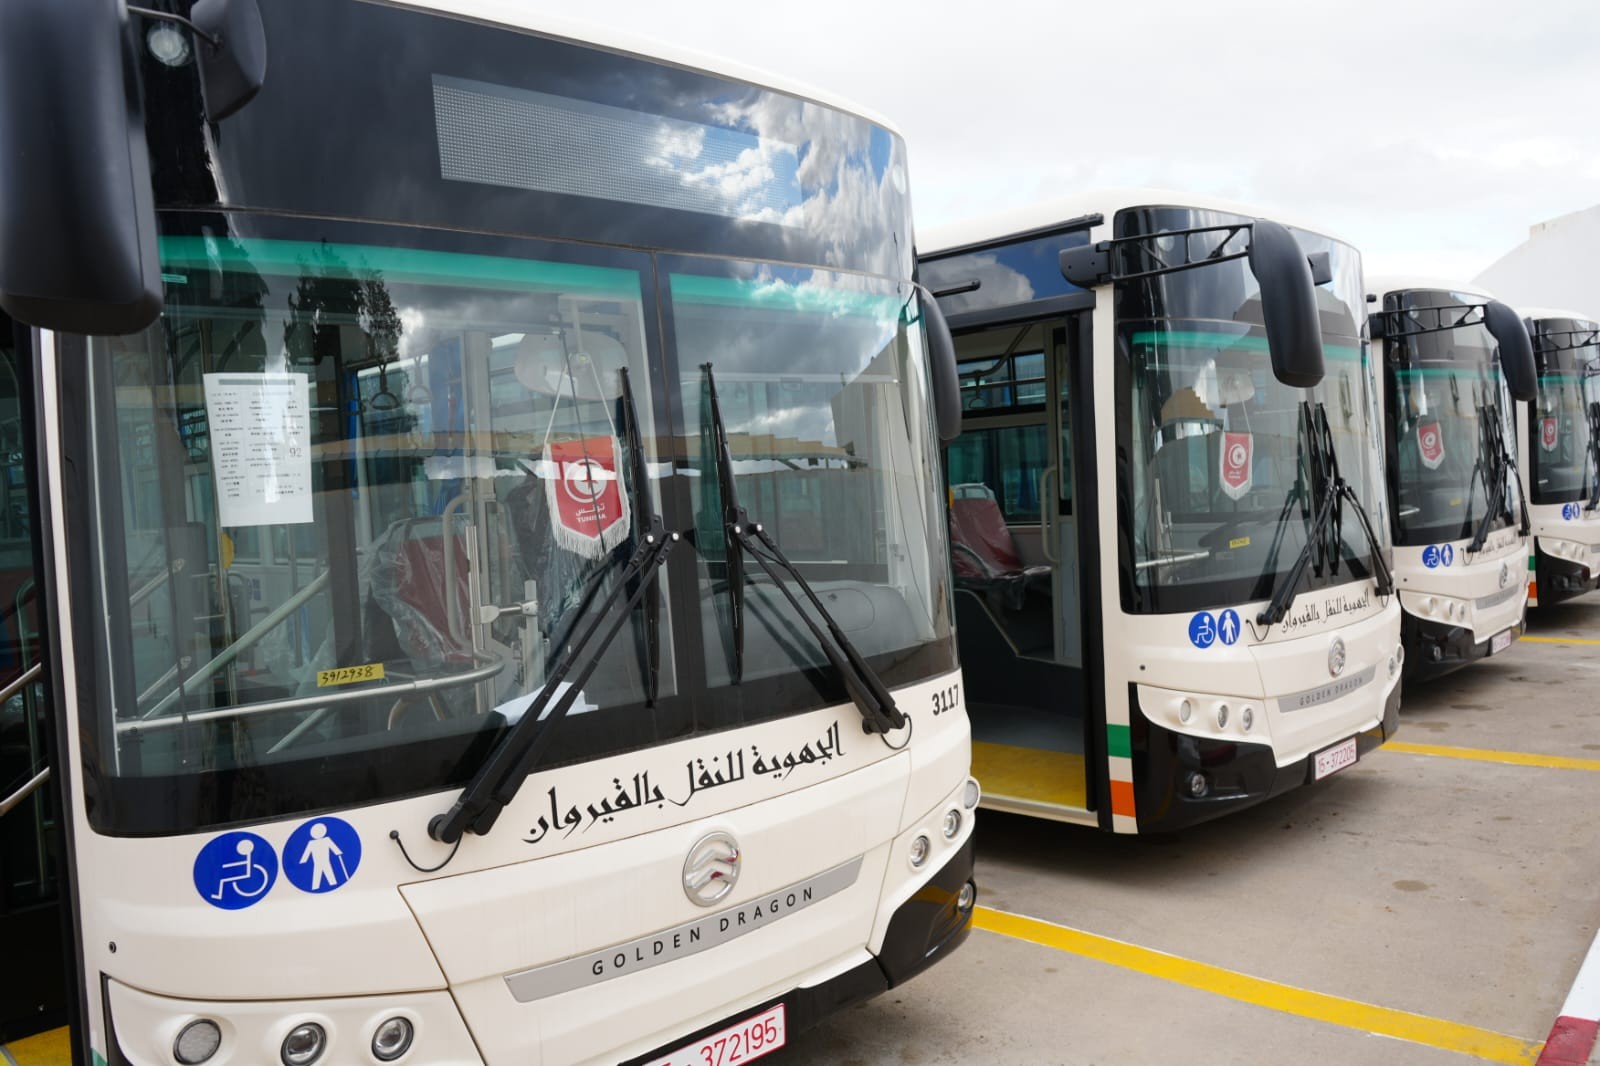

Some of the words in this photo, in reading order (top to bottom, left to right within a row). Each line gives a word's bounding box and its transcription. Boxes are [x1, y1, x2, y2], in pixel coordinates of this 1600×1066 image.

[931, 684, 959, 716] 3117
[521, 769, 666, 844] بالقيروان
[668, 749, 745, 807] للنقل
[592, 927, 701, 976] GOLDEN
[719, 886, 813, 932] DRAGON
